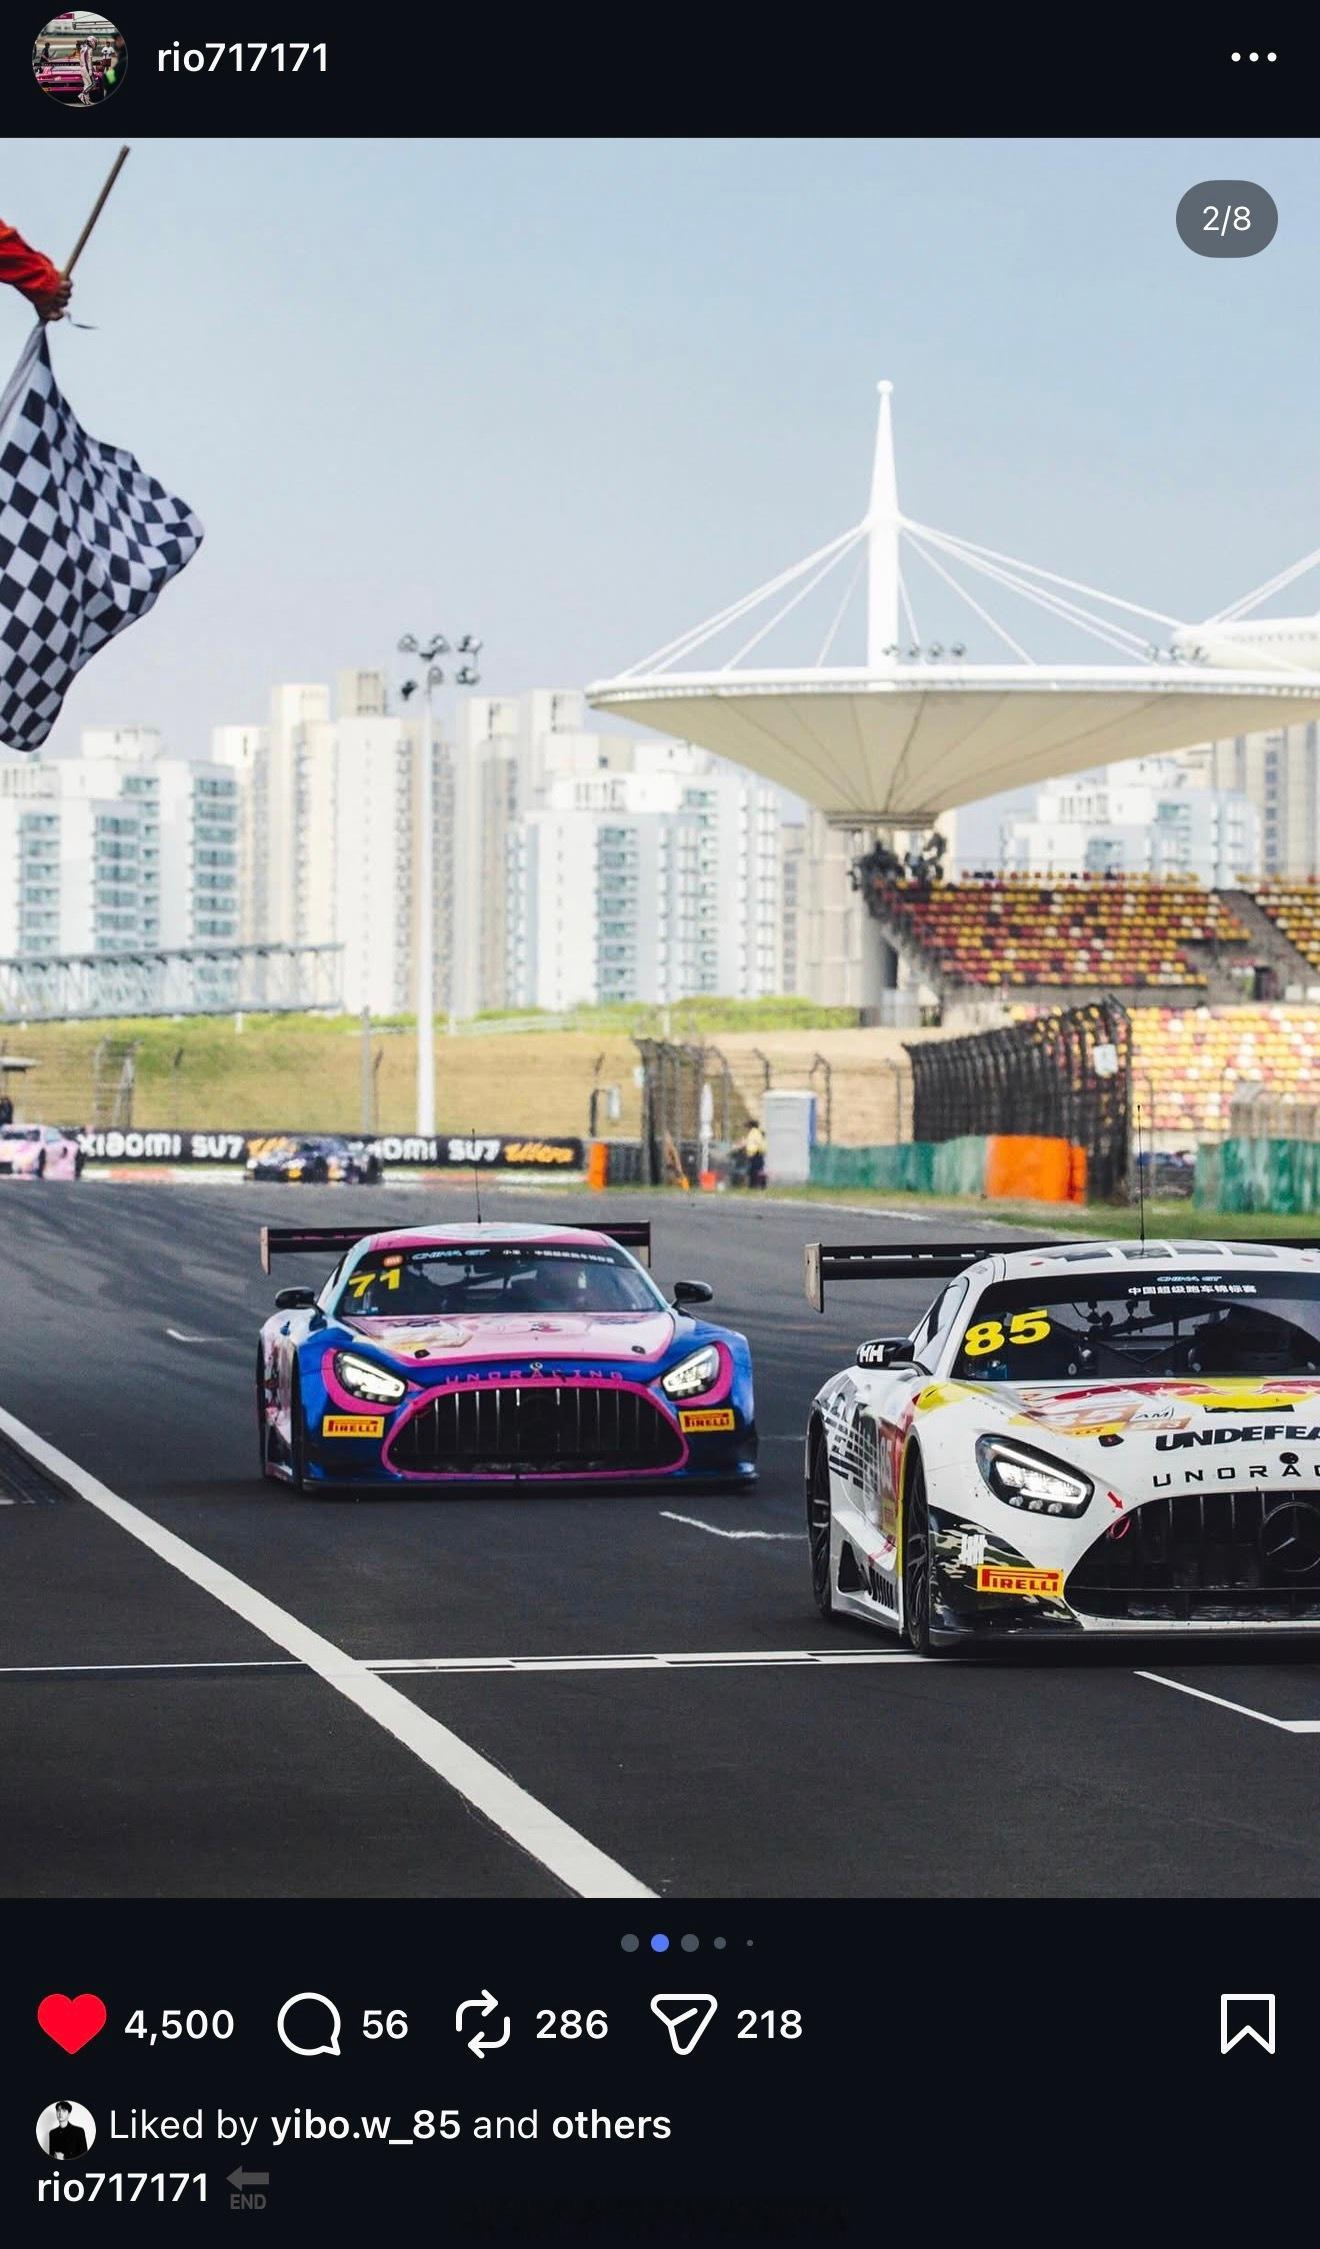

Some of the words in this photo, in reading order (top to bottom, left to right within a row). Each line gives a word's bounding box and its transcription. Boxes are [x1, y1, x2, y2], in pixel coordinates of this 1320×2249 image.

[190, 1133, 245, 1159] SU7
[448, 1138, 501, 1162] SU7
[348, 1268, 401, 1298] 71
[964, 1309, 1051, 1356] 85
[859, 1344, 885, 1363] HH
[328, 1419, 379, 1432] PIRELLI
[684, 1412, 730, 1428] PIRELLI
[981, 1568, 1060, 1593] PIRELLI
